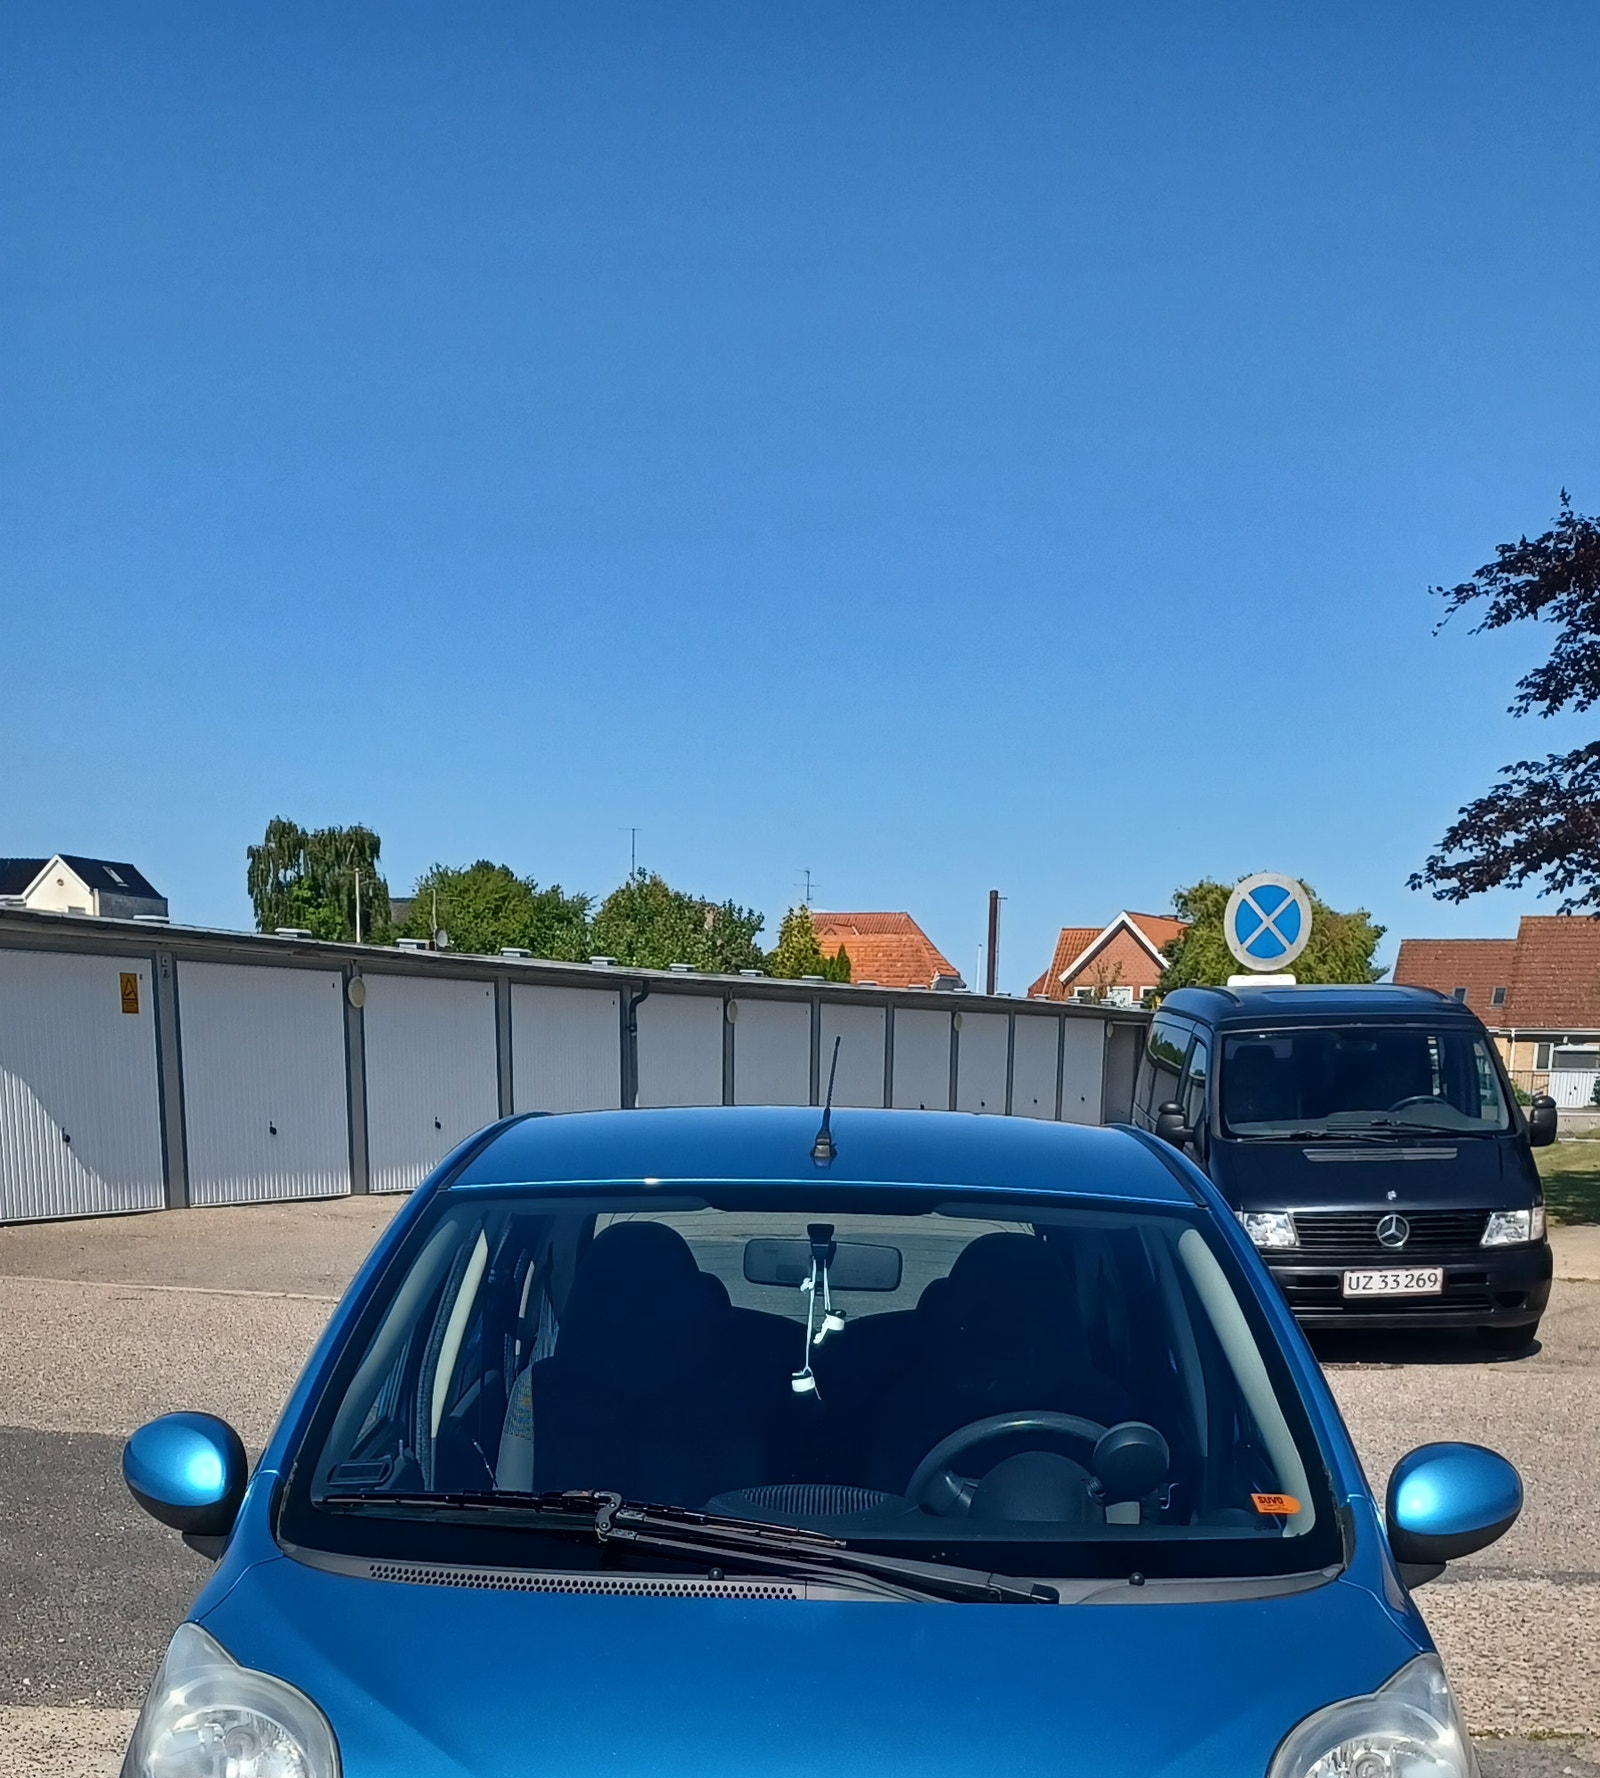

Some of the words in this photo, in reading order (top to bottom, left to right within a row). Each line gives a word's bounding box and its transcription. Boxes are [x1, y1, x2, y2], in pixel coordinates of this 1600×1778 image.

[1348, 1275, 1374, 1291] UZ
[1378, 1274, 1400, 1290] 33
[1404, 1272, 1439, 1289] 269
